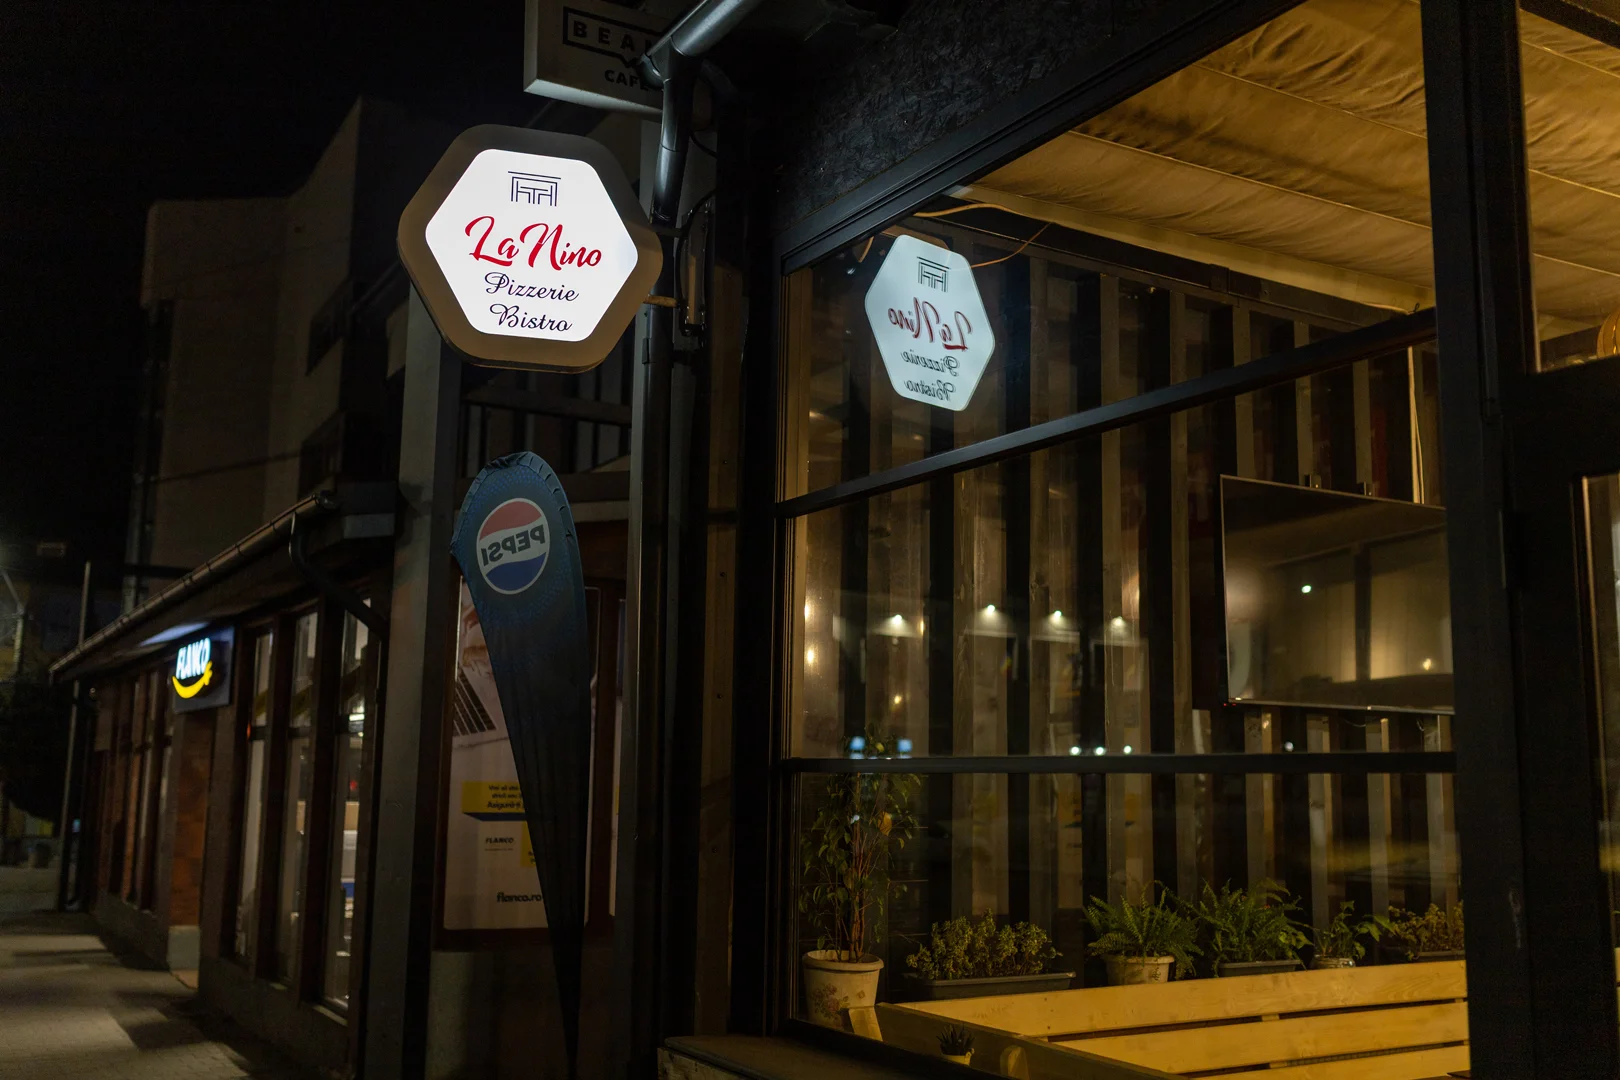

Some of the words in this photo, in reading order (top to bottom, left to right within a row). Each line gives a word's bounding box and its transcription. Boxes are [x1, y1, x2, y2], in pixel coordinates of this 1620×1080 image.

[464, 215, 520, 267] La
[519, 222, 602, 271] Nino
[484, 271, 580, 302] Pizzerie
[489, 303, 573, 332] Bistro
[496, 891, 542, 903] flanco.ro
